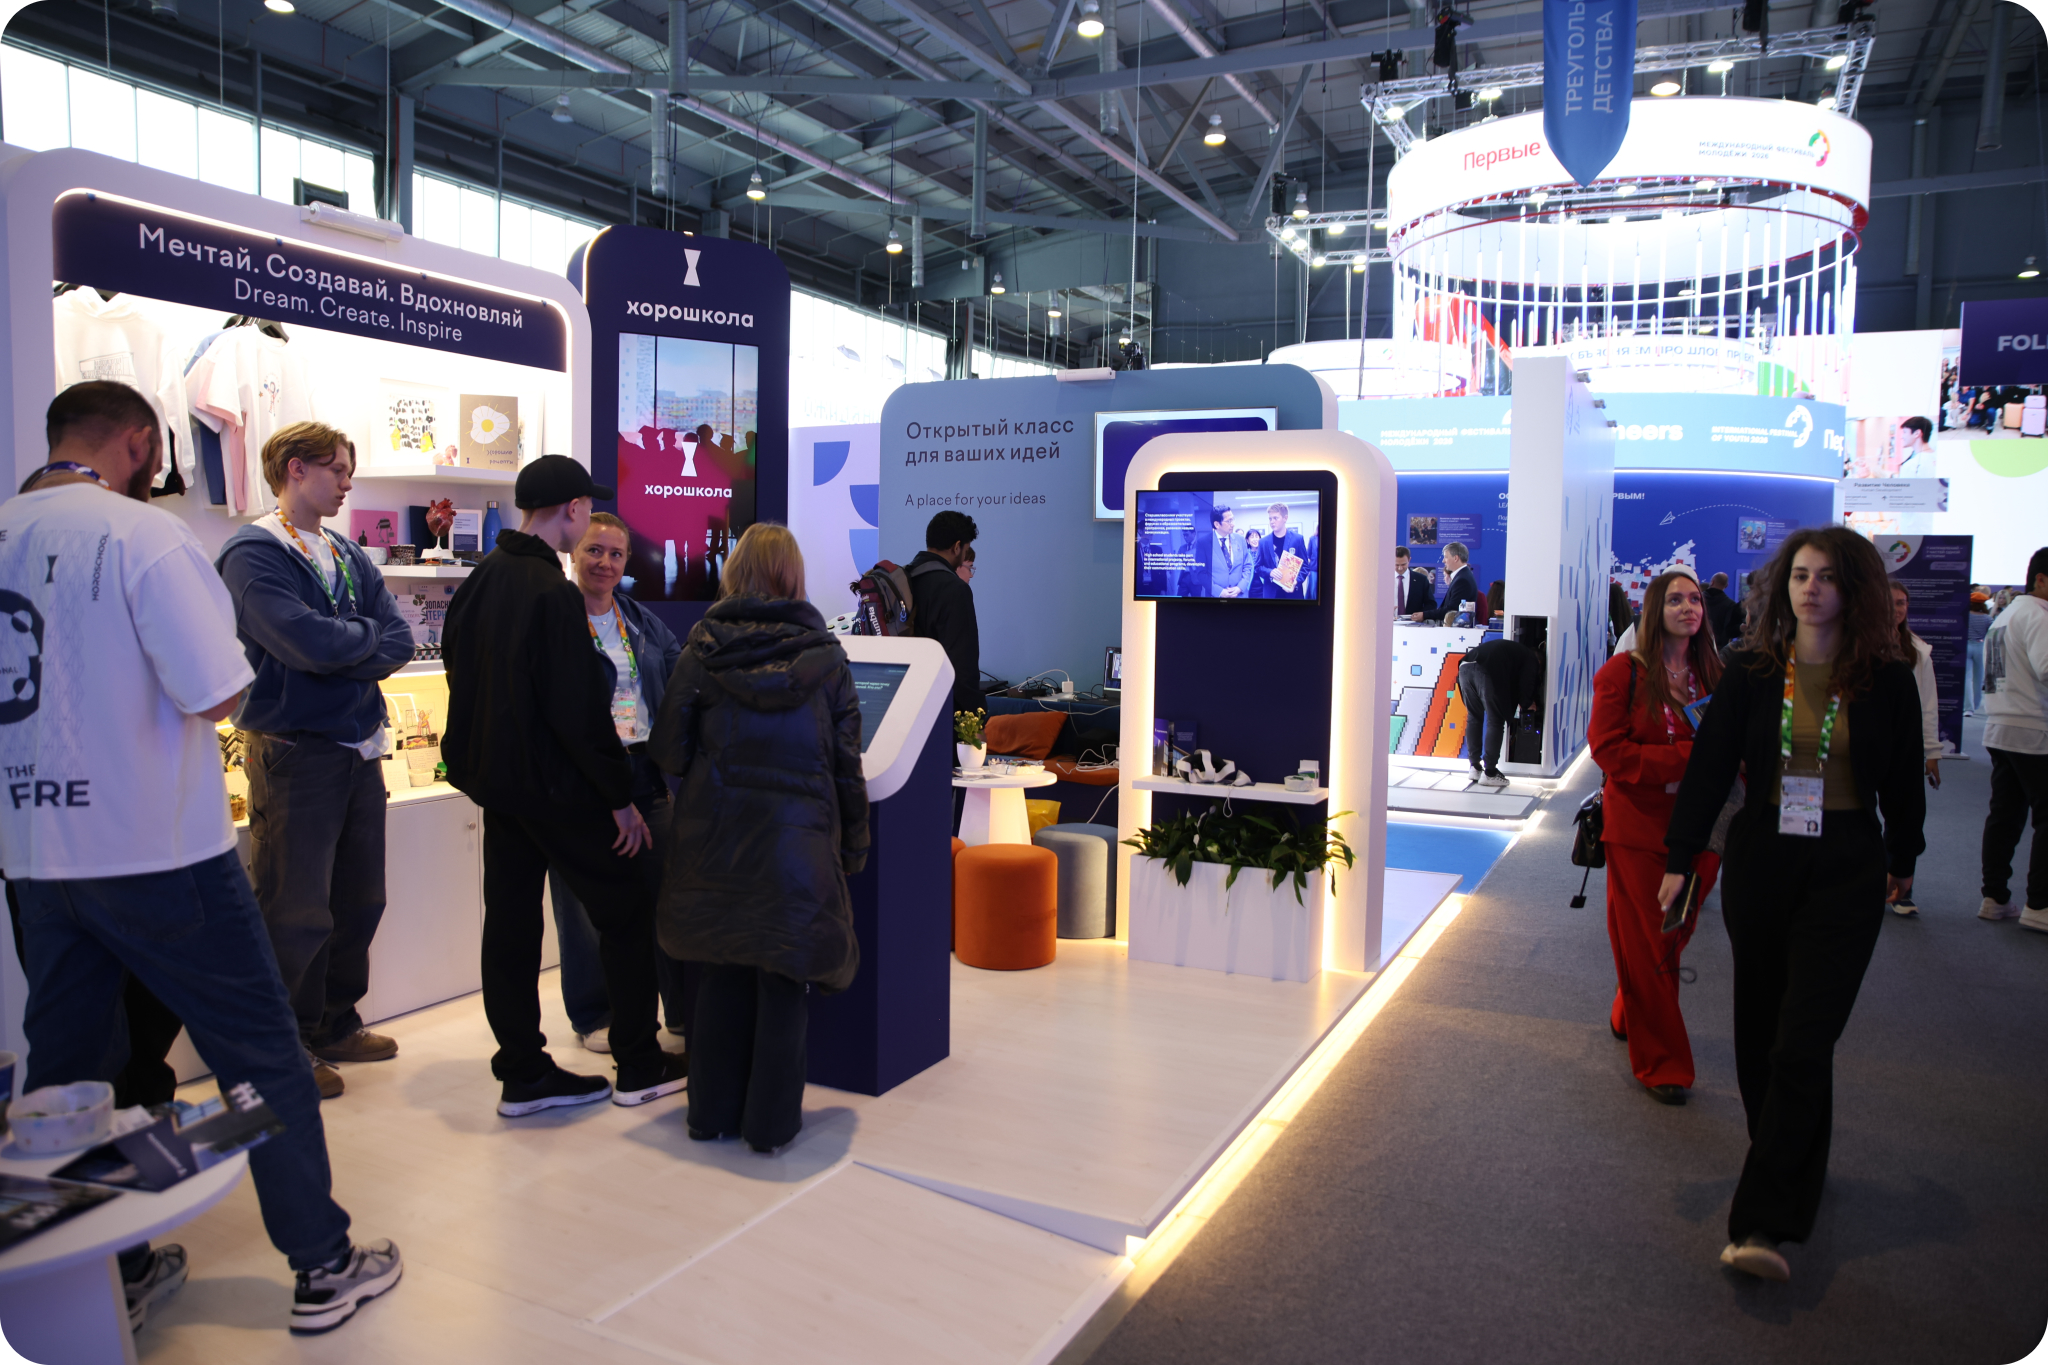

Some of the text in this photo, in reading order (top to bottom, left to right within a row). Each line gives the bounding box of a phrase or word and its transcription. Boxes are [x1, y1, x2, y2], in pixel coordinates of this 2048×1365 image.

[1565, 0, 1586, 116] ТРЕУГОЛЬ
[1593, 10, 1614, 114] ДЕТСТВА
[1464, 142, 1541, 171] Первые
[1699, 141, 1815, 158] МЕЖДУНАРОДНЫЙ ФЕСТИВАЛЬ
[139, 222, 523, 329] Мечтай. Создавай. Вдохновляй
[235, 278, 463, 341] Dream. Create. Inspire
[626, 300, 754, 328] хорошкола
[1998, 334, 2048, 351] FOL
[906, 418, 1074, 442] Открытый класс
[1381, 428, 1458, 438] МЕЖДУНАРОДНЫЙ
[1612, 424, 1683, 440] neers
[1711, 426, 1798, 438] INTERNATIONAL FESTIVAL
[1724, 435, 1749, 443] YOUTH
[905, 441, 1060, 466] для ваших идей
[1824, 429, 1844, 457] Пер
[644, 484, 733, 498] хорошкола
[905, 491, 1046, 509] A place for your ideas
[91, 533, 109, 601] HOROSCHOOL
[425, 600, 452, 610] ЗОПАСН
[4, 764, 36, 779] THE
